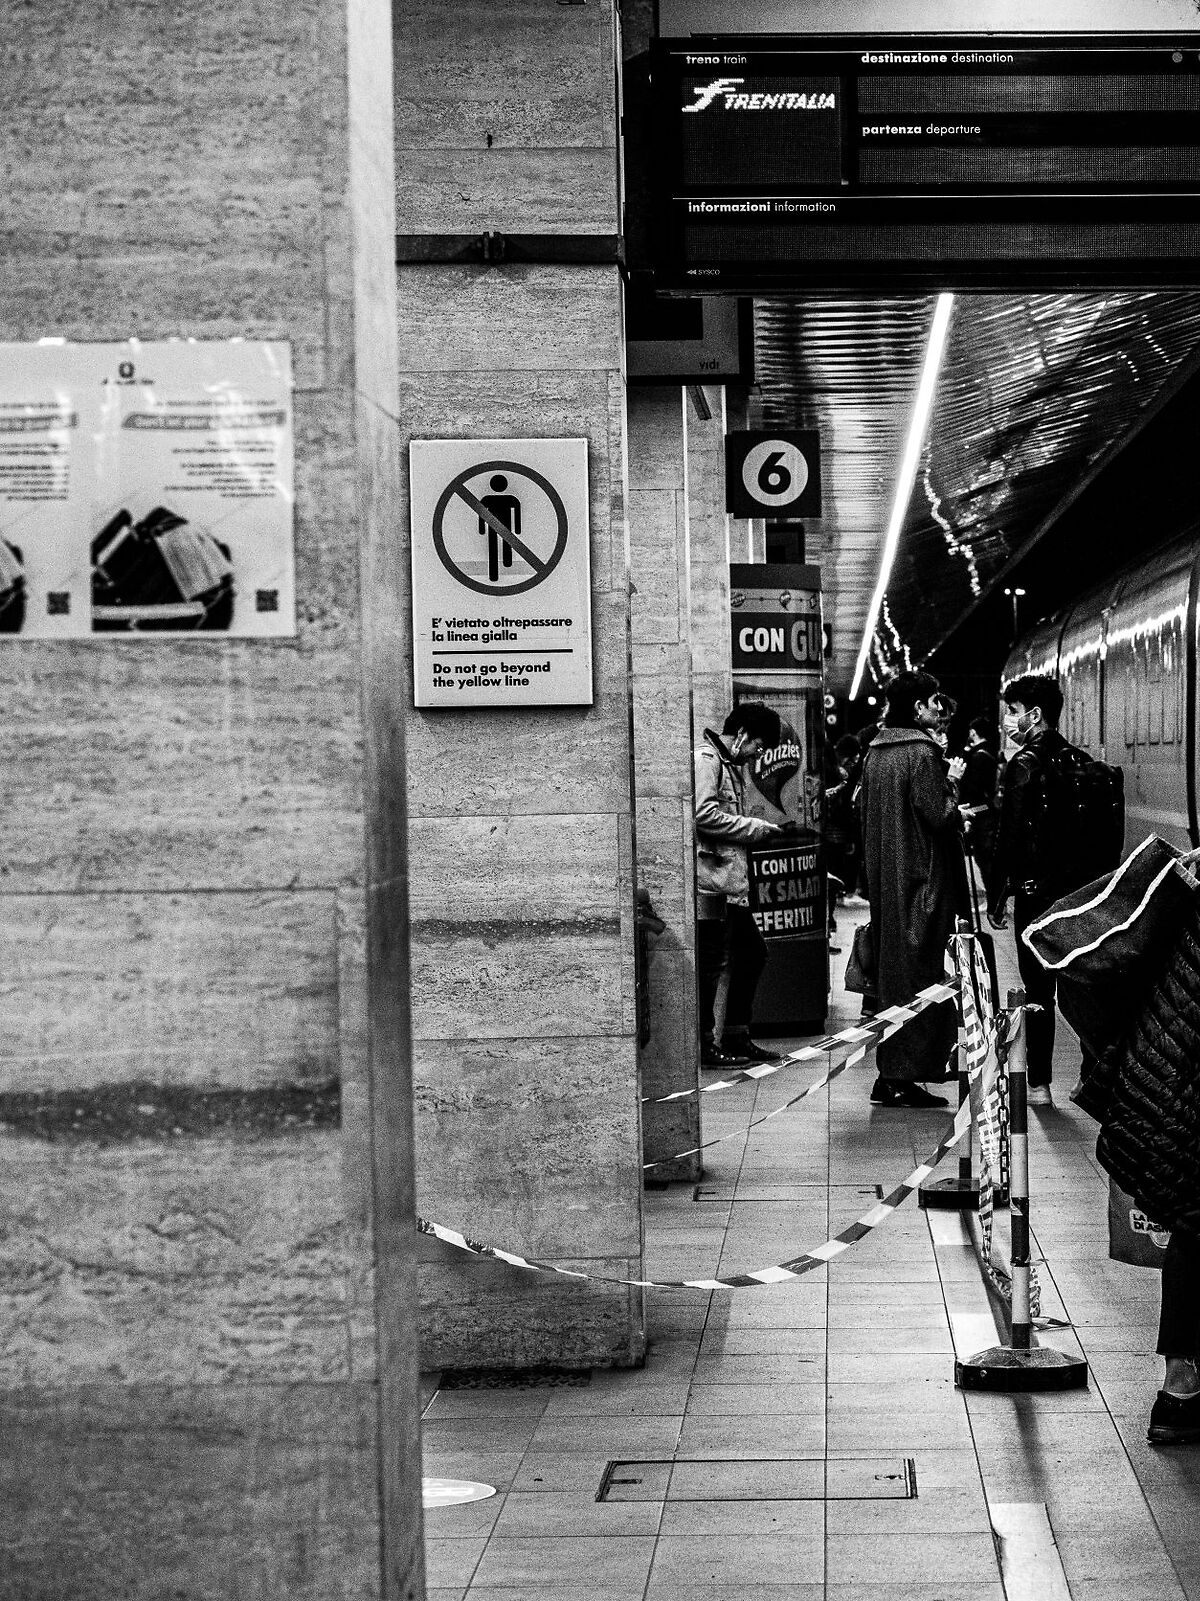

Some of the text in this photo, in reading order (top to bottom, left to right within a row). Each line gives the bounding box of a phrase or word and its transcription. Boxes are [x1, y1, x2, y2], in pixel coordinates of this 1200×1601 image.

[686, 55, 747, 64] treno train
[861, 52, 1014, 63] destinazione destination
[724, 93, 835, 109] TRENITALIA
[862, 123, 981, 136] partenza departure
[688, 200, 836, 212] informazioni information
[757, 452, 792, 495] 6
[445, 617, 490, 628] vietato
[492, 616, 573, 630] oltrepassare
[432, 630, 518, 643] la linea gialla
[739, 620, 821, 661] CON GU
[433, 661, 551, 675] Do not go beyond
[433, 675, 530, 689] the yellow line
[761, 858, 788, 876] CON
[791, 857, 795, 872] I
